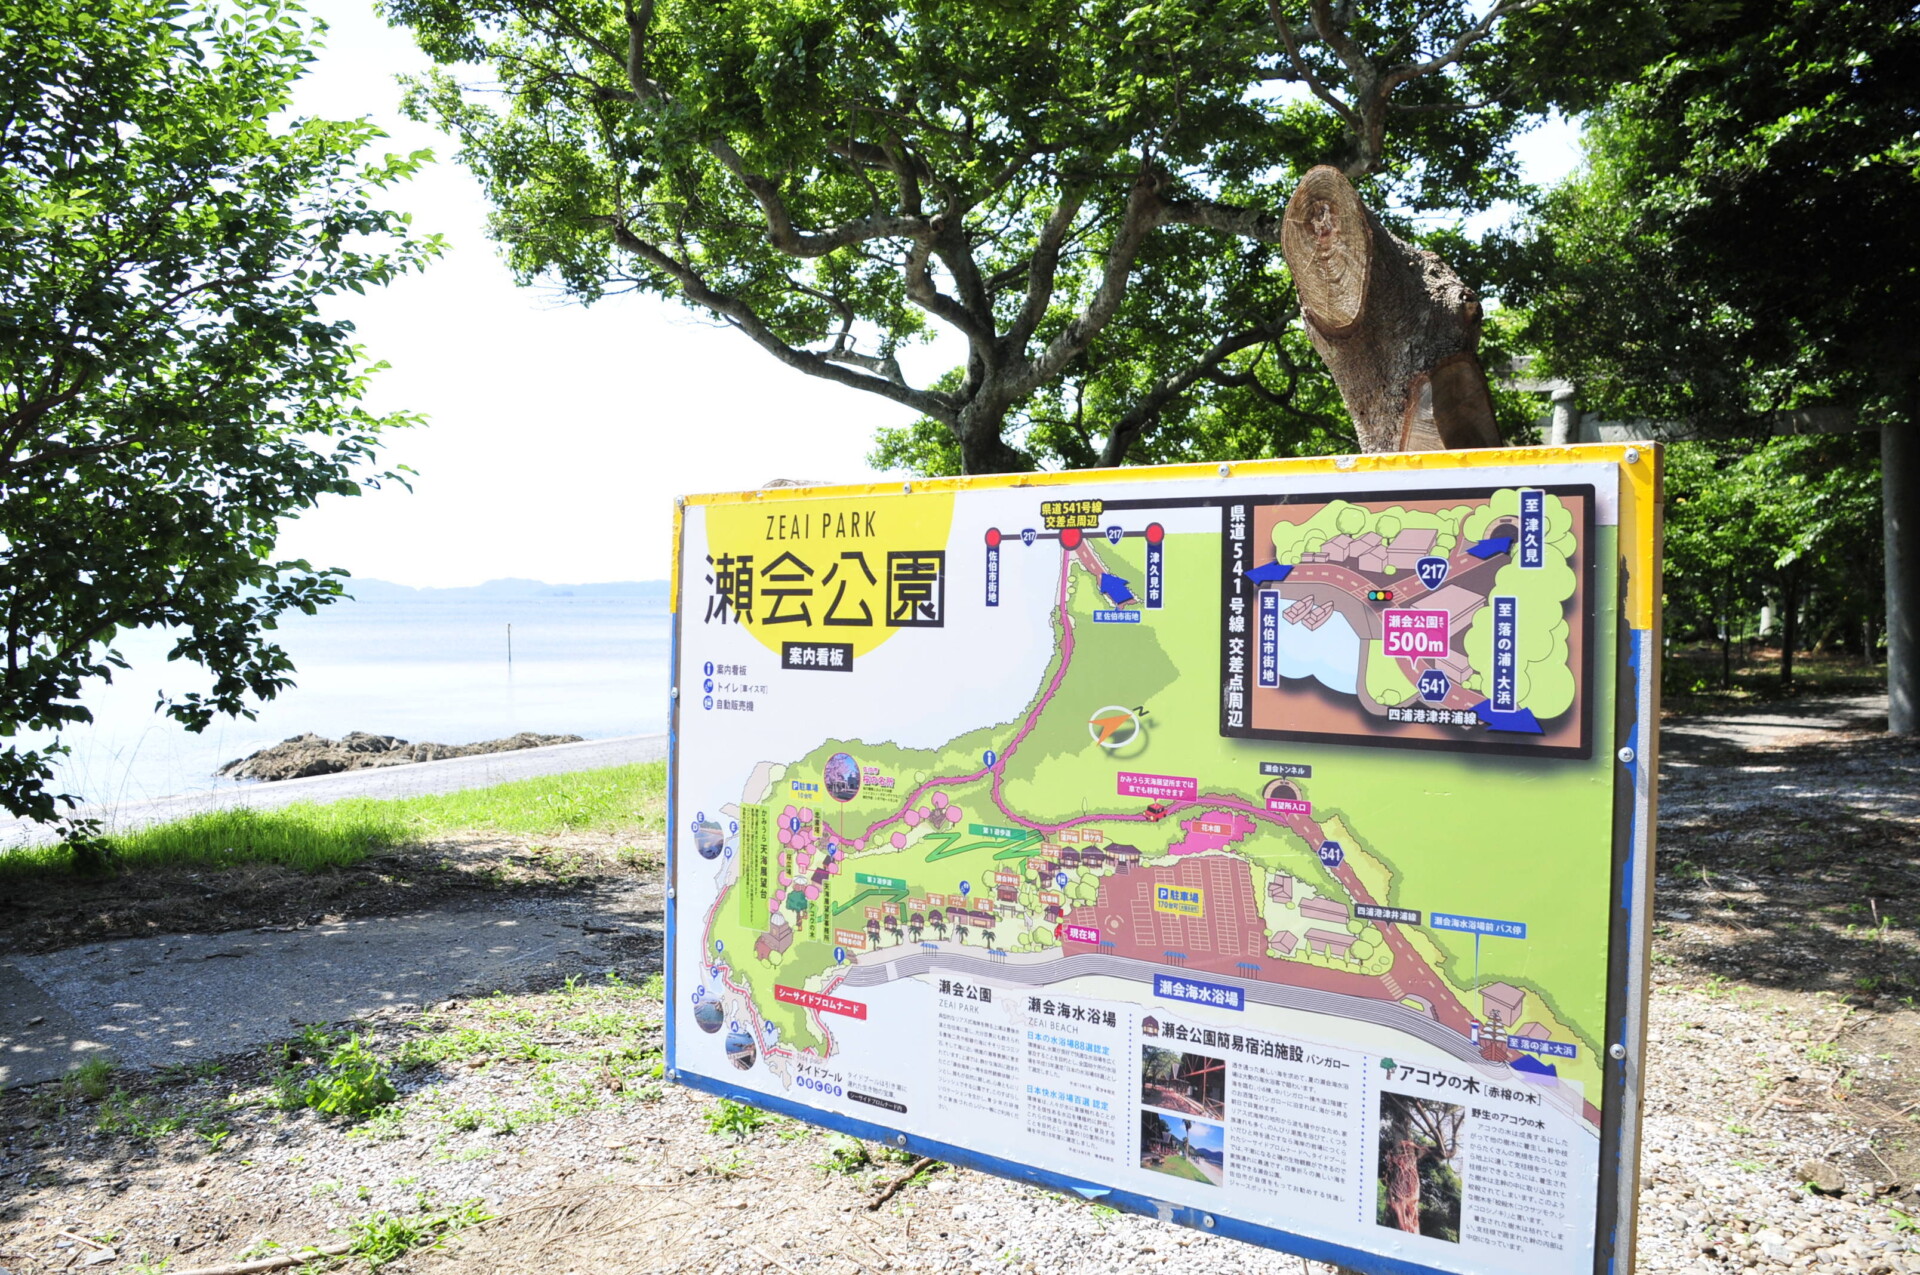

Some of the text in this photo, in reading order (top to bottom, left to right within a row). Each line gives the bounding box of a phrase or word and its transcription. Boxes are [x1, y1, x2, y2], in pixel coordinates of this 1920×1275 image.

[1042, 502, 1103, 514] 県道541号線
[766, 511, 876, 540] ZEAI PARK
[1045, 515, 1098, 528] 交差点周辺
[1023, 532, 1035, 541] 217
[1109, 529, 1121, 539] 217
[1525, 499, 1539, 563] 至 津久見
[988, 552, 998, 602] 佐伯市街地
[1150, 552, 1160, 600] 津久見市
[1422, 564, 1445, 579] 217
[704, 550, 945, 628] 瀬会公園
[1103, 612, 1139, 621] 佐伯市街地
[1228, 505, 1246, 727] 県道541号線 交差点周辺
[1389, 615, 1438, 629] 瀬会公園
[1262, 596, 1275, 683] 至 佐伯市街地
[1389, 632, 1443, 653] 500m
[789, 647, 844, 666] 案内看板
[1498, 604, 1511, 705] 至 落の浦・大浜
[716, 664, 747, 676] 案内看板
[717, 682, 739, 693] トイレ
[1421, 679, 1445, 693] 541
[716, 699, 754, 711] 自動販売機
[1388, 709, 1477, 726] 四浦港津井浦線
[1265, 765, 1305, 775] 瀬会トンネル
[1271, 800, 1306, 812] 展望所入口
[1321, 848, 1340, 860] 541
[1357, 906, 1417, 922] 四浦港津井浦線
[1070, 926, 1097, 941] 現在地
[1496, 924, 1522, 936] バス停
[939, 980, 991, 1002] 瀬会公園
[1159, 979, 1239, 1008] 瀬会海水浴場
[779, 989, 859, 1014] シーサイドプロムナード
[939, 1000, 979, 1014] ZEAI PARK
[1028, 997, 1116, 1028] 瀬会海水浴場
[1028, 1017, 1078, 1034] ZEAI BEACH
[1162, 1022, 1349, 1068] 瀬会公園簡易宿泊施設 バンガロー
[1520, 1039, 1573, 1056] 落の浦・大浜
[797, 1063, 843, 1082] タイドプール
[1400, 1065, 1480, 1095] アコウの木
[1093, 1100, 1108, 1111] 認定
[1472, 1108, 1545, 1129] 野生のアコウの木
